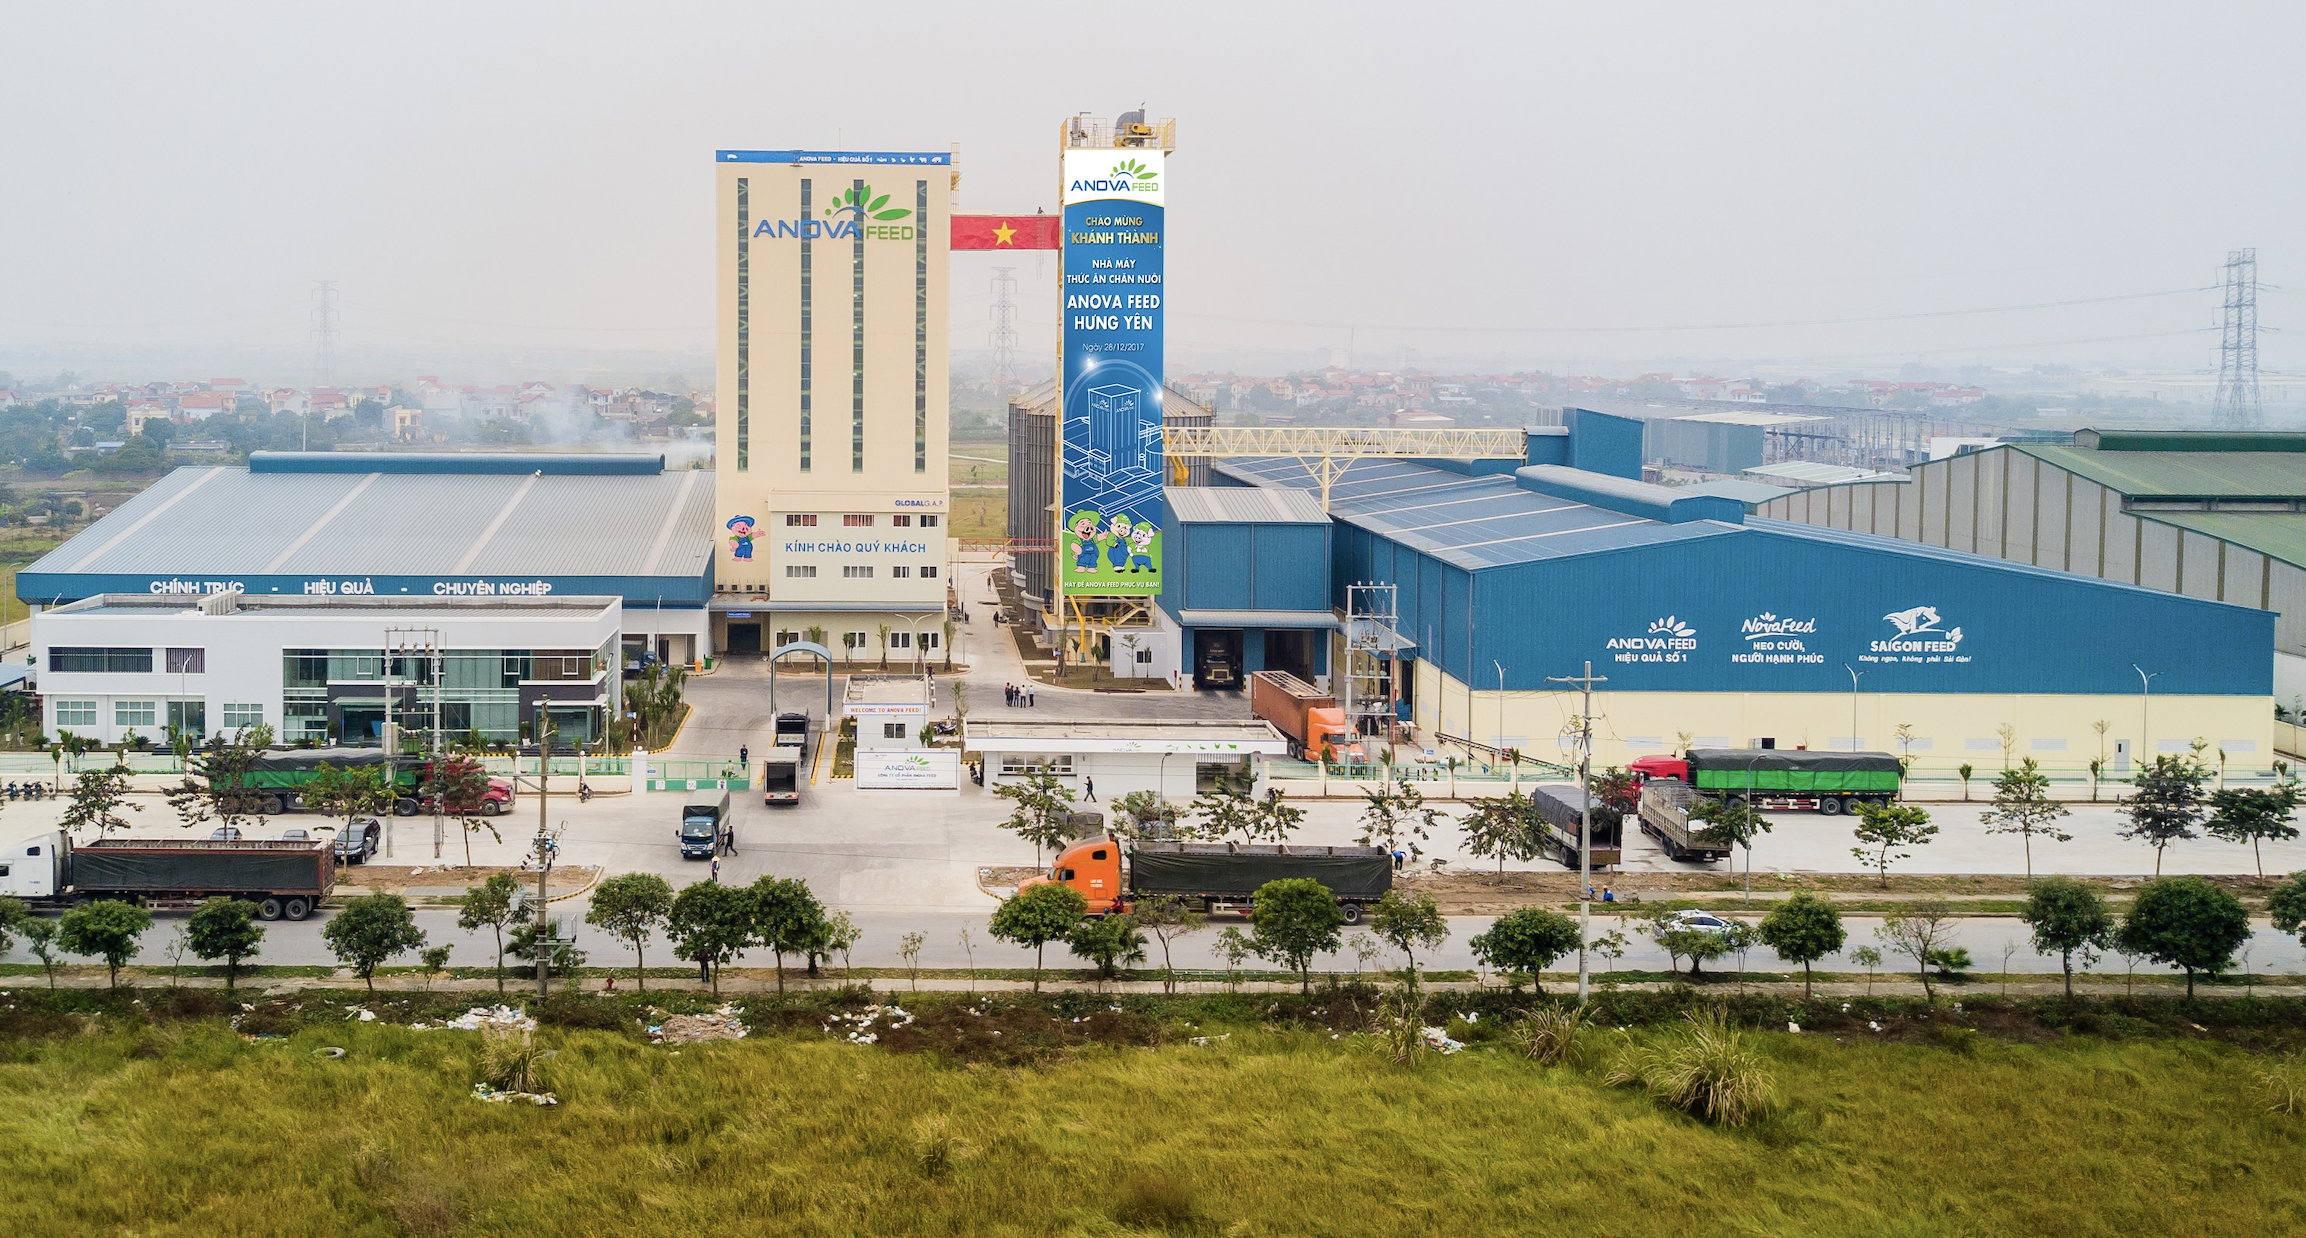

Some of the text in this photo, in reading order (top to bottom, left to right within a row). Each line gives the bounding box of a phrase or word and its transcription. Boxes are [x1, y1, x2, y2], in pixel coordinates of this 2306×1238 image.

[1071, 180, 1158, 191] ANOVA FEED
[1086, 215, 1143, 226] CHÀO MỪNG
[753, 219, 914, 240] ANOVA FEED
[1071, 229, 1158, 244] KHÁNH THÀNH
[1092, 257, 1136, 269] NHÀ MÁY
[1067, 272, 1090, 284] THỨC
[1138, 272, 1161, 284] NUÔI
[1067, 294, 1161, 309] ANOVA FEED
[1074, 312, 1153, 330] HƯNG YÊN
[1082, 343, 1145, 352] Ngày 28/12/2017
[785, 540, 926, 553] KÍNH CHÀO QUÝ KHÁCH
[150, 578, 200, 594] CHÍNH
[304, 579, 337, 595] HIỆU
[340, 577, 374, 594] QUẢ
[433, 580, 495, 594] CHUYÊN
[499, 580, 552, 596] NGHIỆP
[1741, 617, 1817, 633] NovaFeed
[1606, 638, 1697, 650] ANOVA FEED
[1753, 639, 1805, 652] HEO CƯỜI,
[1870, 640, 1956, 652] SAIGON FEED
[1615, 651, 1687, 664] HIỆU QUẢ SỐ 1
[1731, 652, 1824, 664] NGƯỜI HẠNH PHÚC
